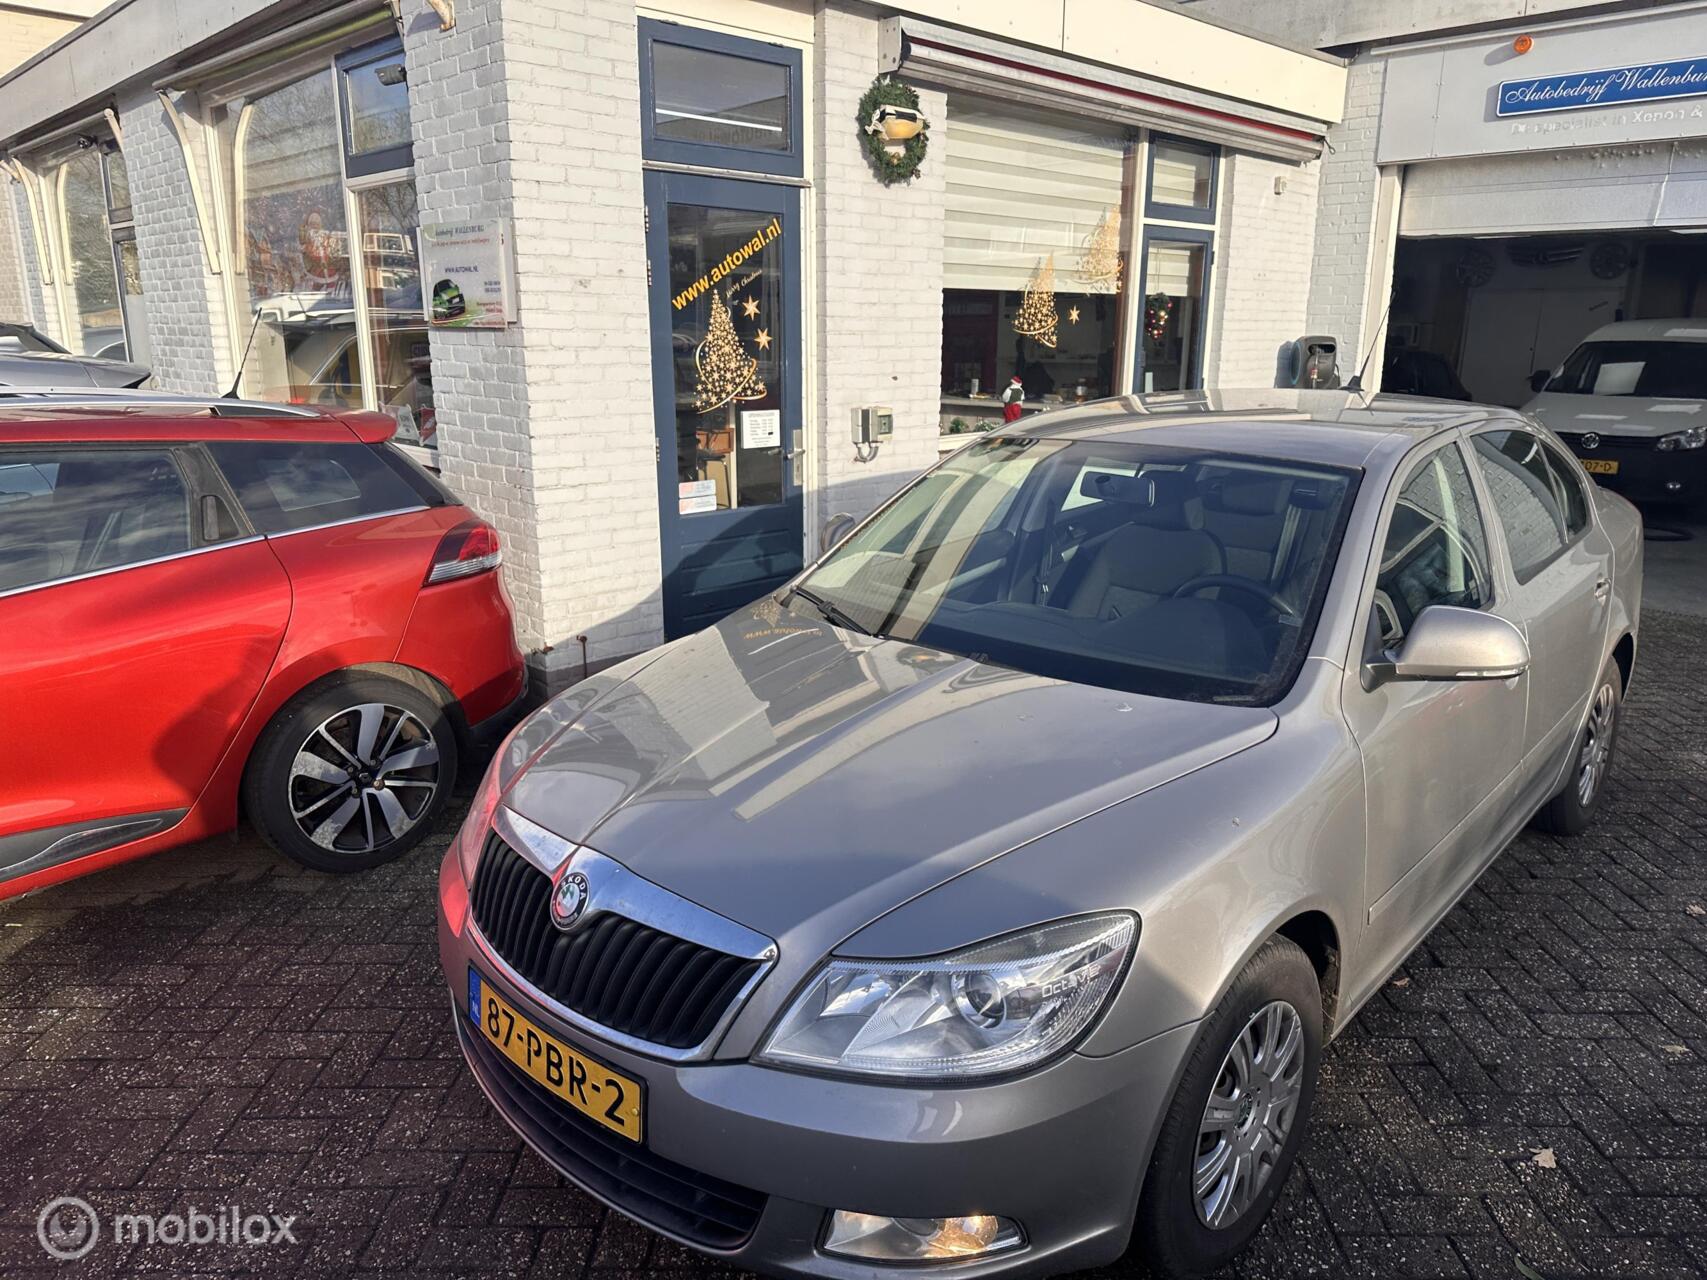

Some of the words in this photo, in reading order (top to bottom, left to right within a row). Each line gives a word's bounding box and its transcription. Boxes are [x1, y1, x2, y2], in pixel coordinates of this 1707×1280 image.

[1505, 73, 1615, 103] Autobedrijf
[1533, 114, 1607, 135] specialist
[1611, 113, 1627, 127] in
[1632, 109, 1685, 123] Xenon
[1689, 104, 1703, 118] &
[672, 217, 782, 310] www.autowal.nl
[1581, 461, 1612, 472] 07-D
[471, 1002, 480, 1018] NL
[487, 997, 625, 1126] 87-PBR-2
